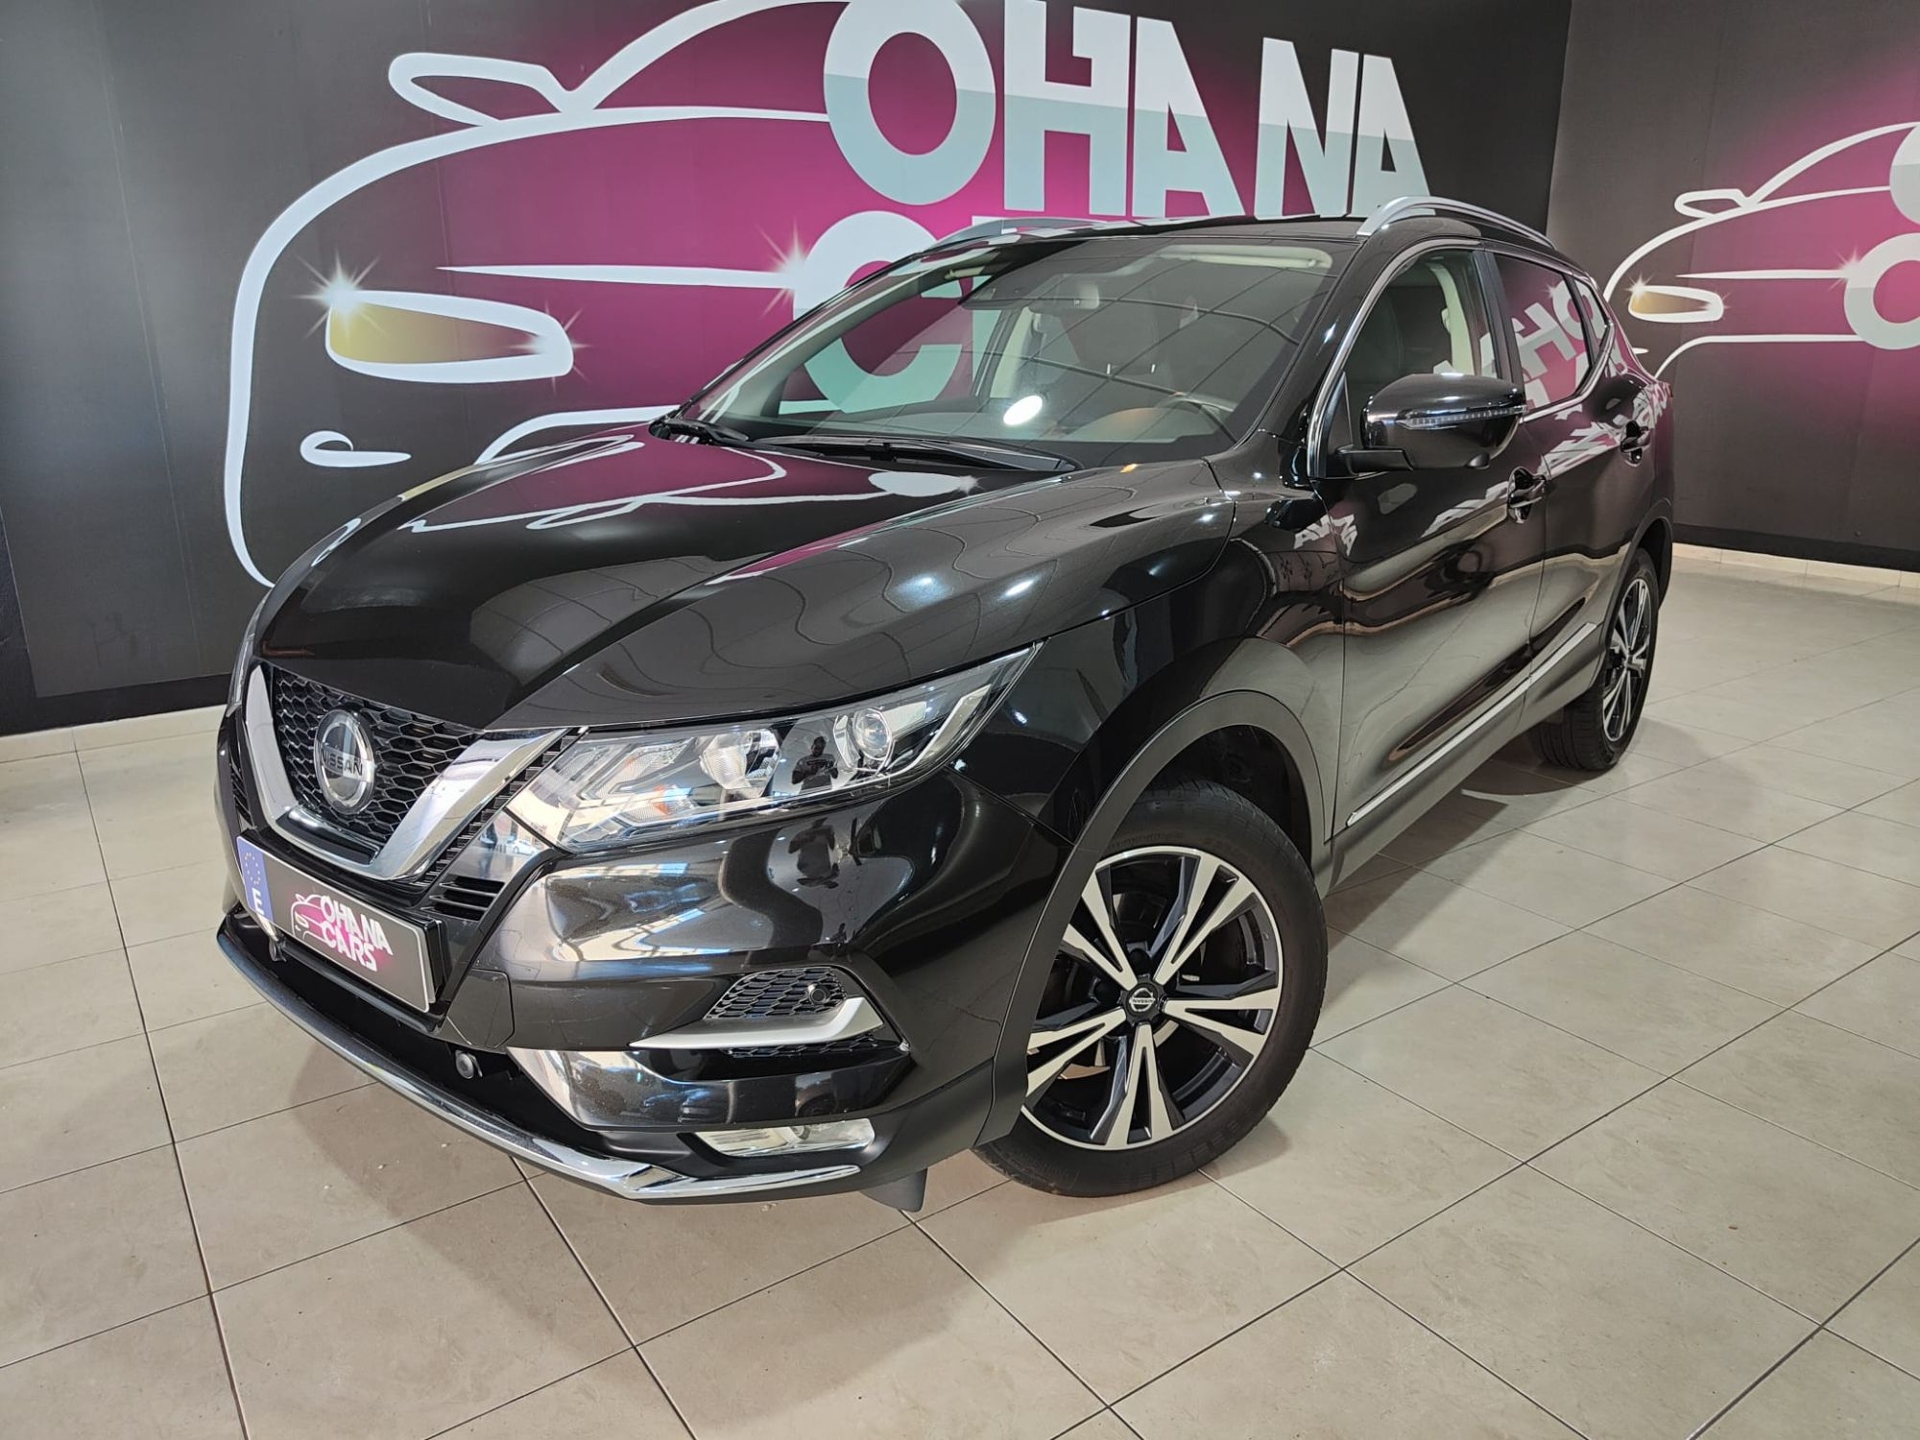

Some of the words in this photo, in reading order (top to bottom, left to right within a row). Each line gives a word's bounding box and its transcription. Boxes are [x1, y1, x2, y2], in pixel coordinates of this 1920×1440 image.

[824, 0, 1433, 219] OHANA
[252, 887, 265, 915] E
[320, 896, 393, 955] OHANA
[322, 921, 378, 972] CARS
